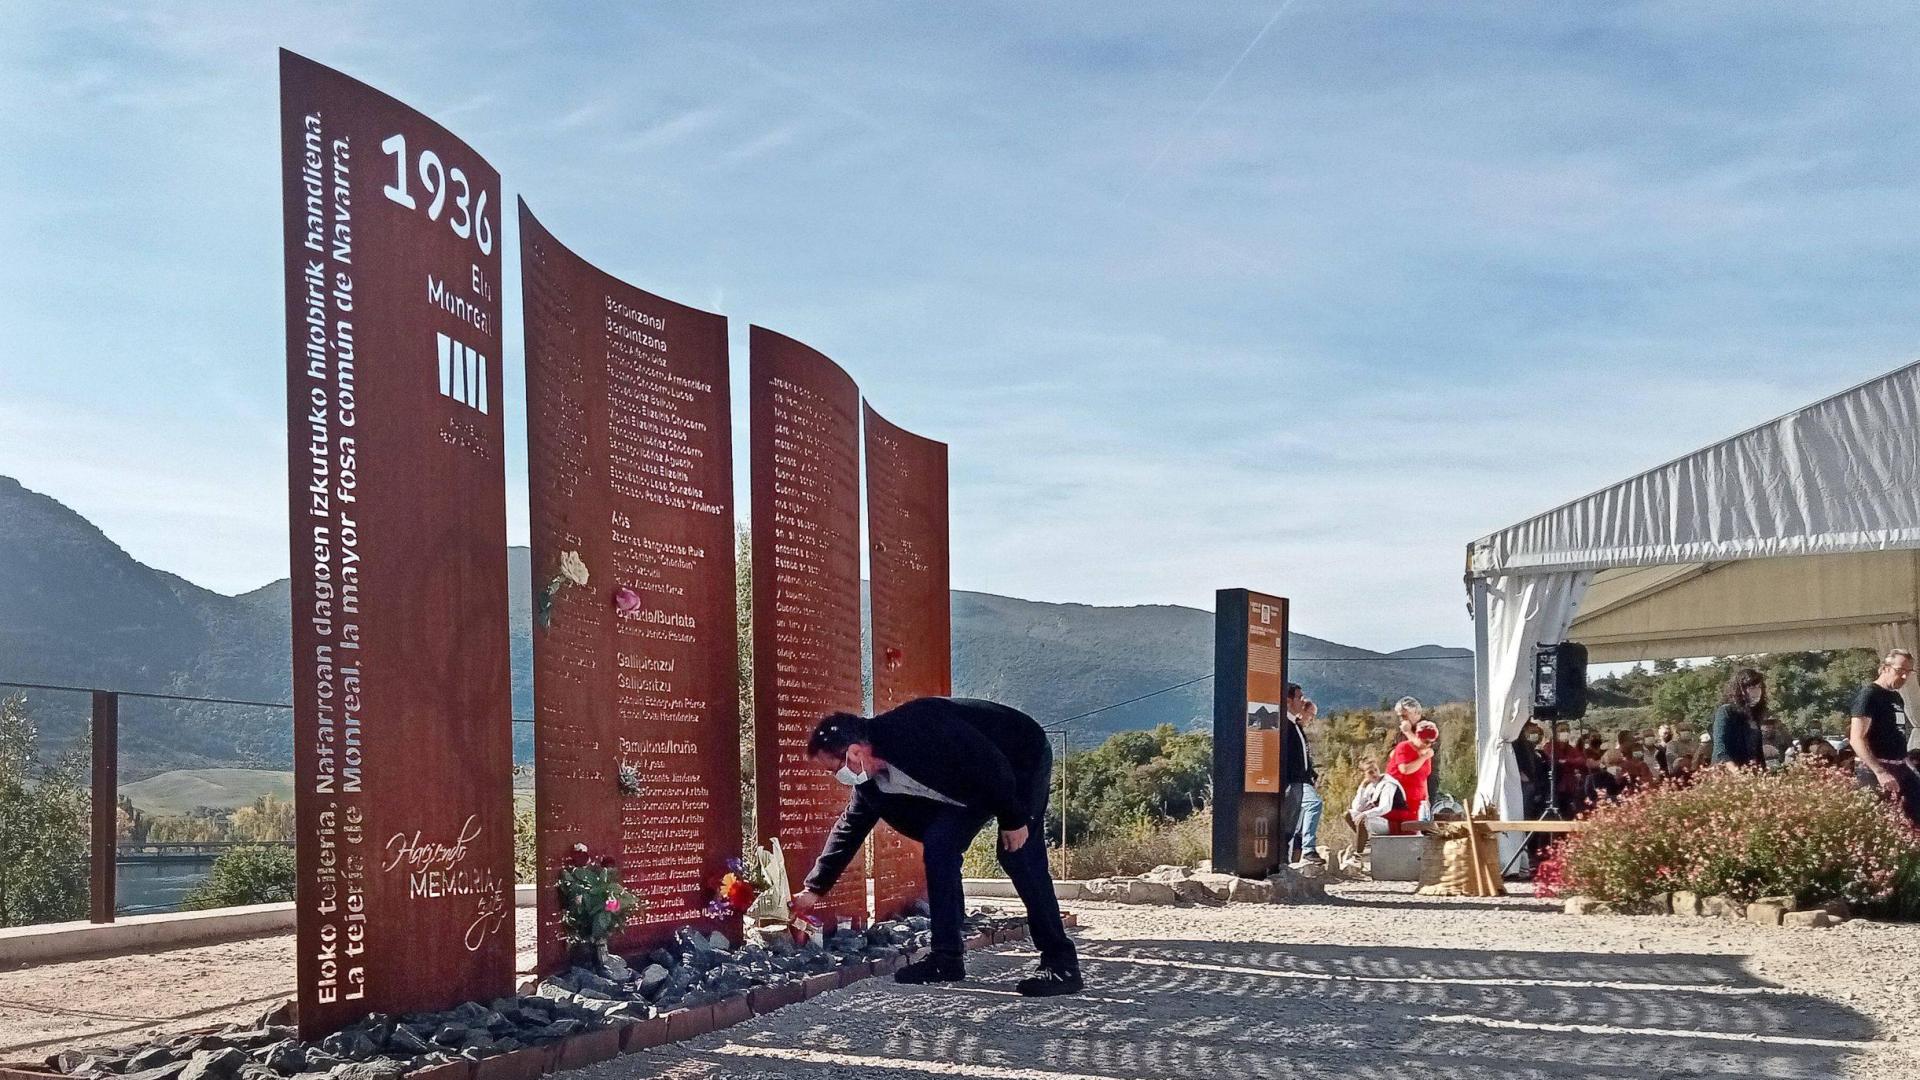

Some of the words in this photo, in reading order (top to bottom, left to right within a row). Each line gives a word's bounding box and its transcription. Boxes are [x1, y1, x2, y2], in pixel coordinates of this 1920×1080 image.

[303, 110, 323, 252] handiena.
[332, 134, 353, 264] Navarra.
[380, 132, 493, 257] 1936
[304, 259, 328, 380] hilobirik
[332, 271, 354, 312] de
[427, 273, 492, 337] Monreal
[605, 316, 667, 352] Berbintzana
[332, 323, 356, 427] común
[309, 386, 330, 517] izkutuko
[336, 437, 357, 504] fosa
[312, 525, 334, 636] dagoen
[340, 511, 361, 614] mayor
[340, 623, 359, 650] la
[315, 645, 335, 794] Nafarroan
[340, 660, 364, 793] Monreal,
[343, 805, 363, 844] de
[317, 923, 337, 1005] Eloko
[345, 966, 365, 1001] La
